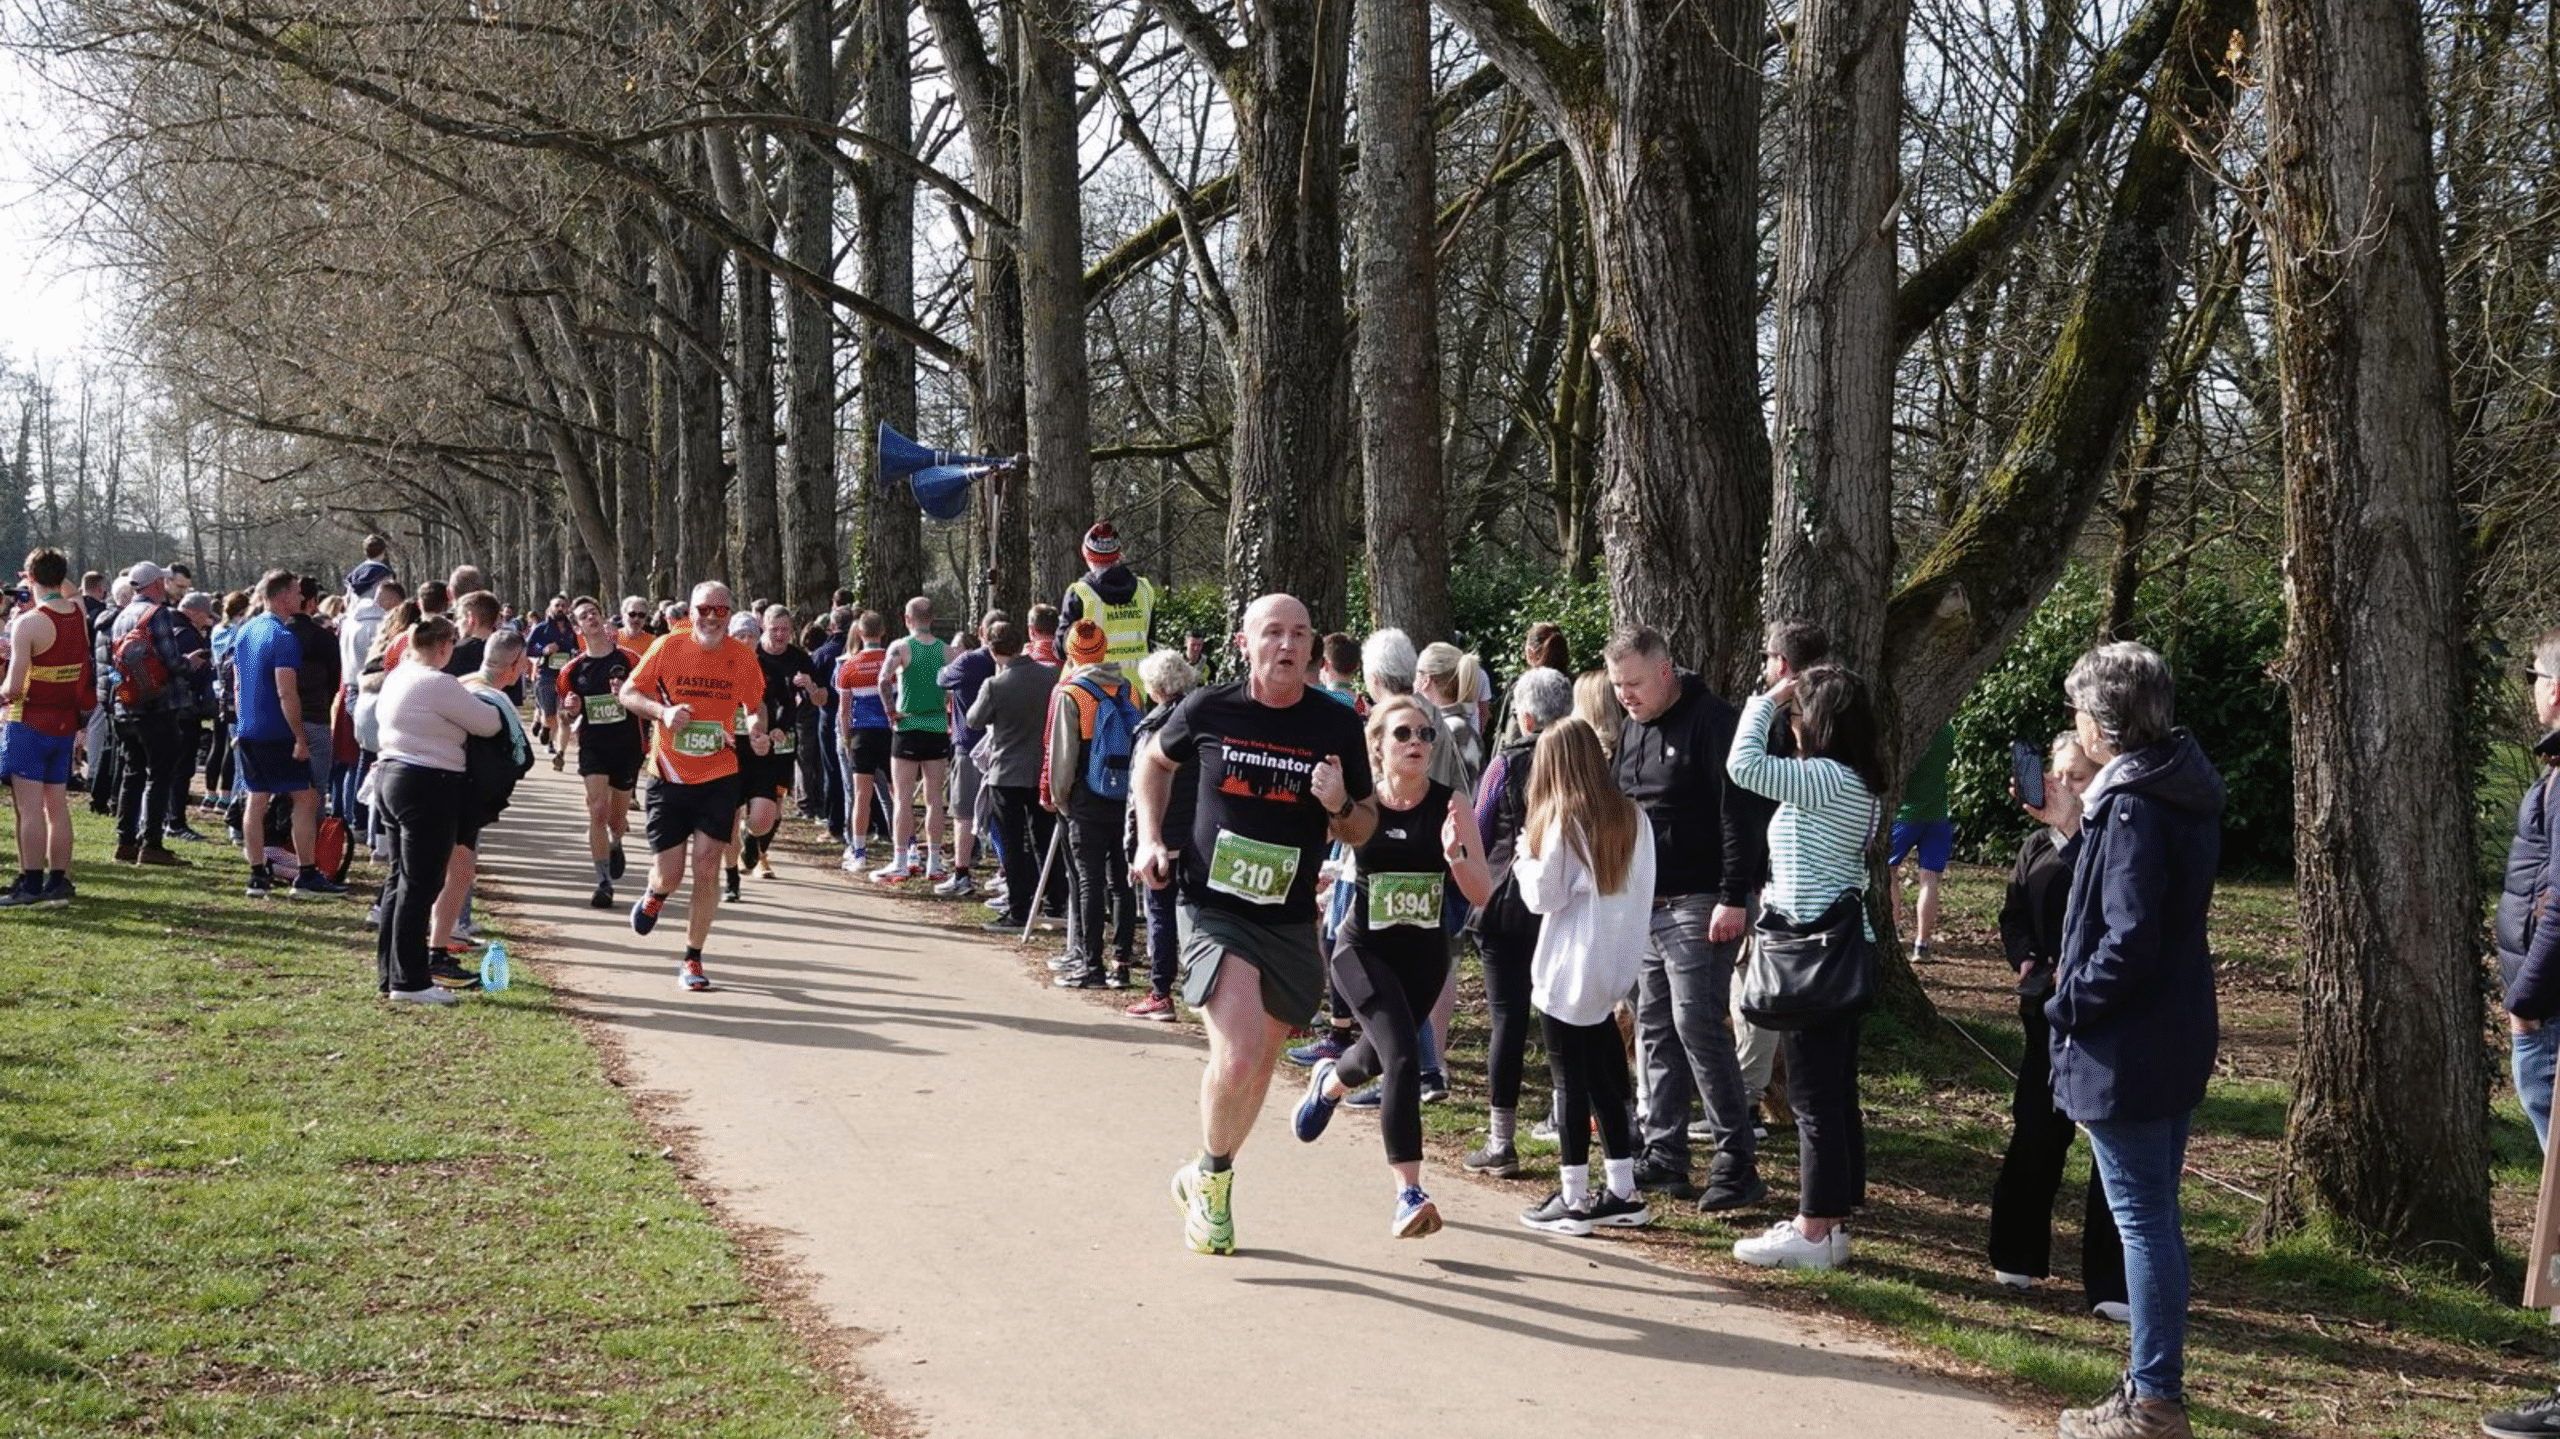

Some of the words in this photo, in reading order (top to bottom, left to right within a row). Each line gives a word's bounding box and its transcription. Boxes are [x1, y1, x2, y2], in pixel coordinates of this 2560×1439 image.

[676, 675, 733, 690] EASTLEIGH
[592, 704, 620, 718] 2102
[683, 733, 715, 749] 1564
[1221, 745, 1312, 774] Terminator
[1230, 858, 1275, 891] 210
[1383, 891, 1431, 917] 1394
